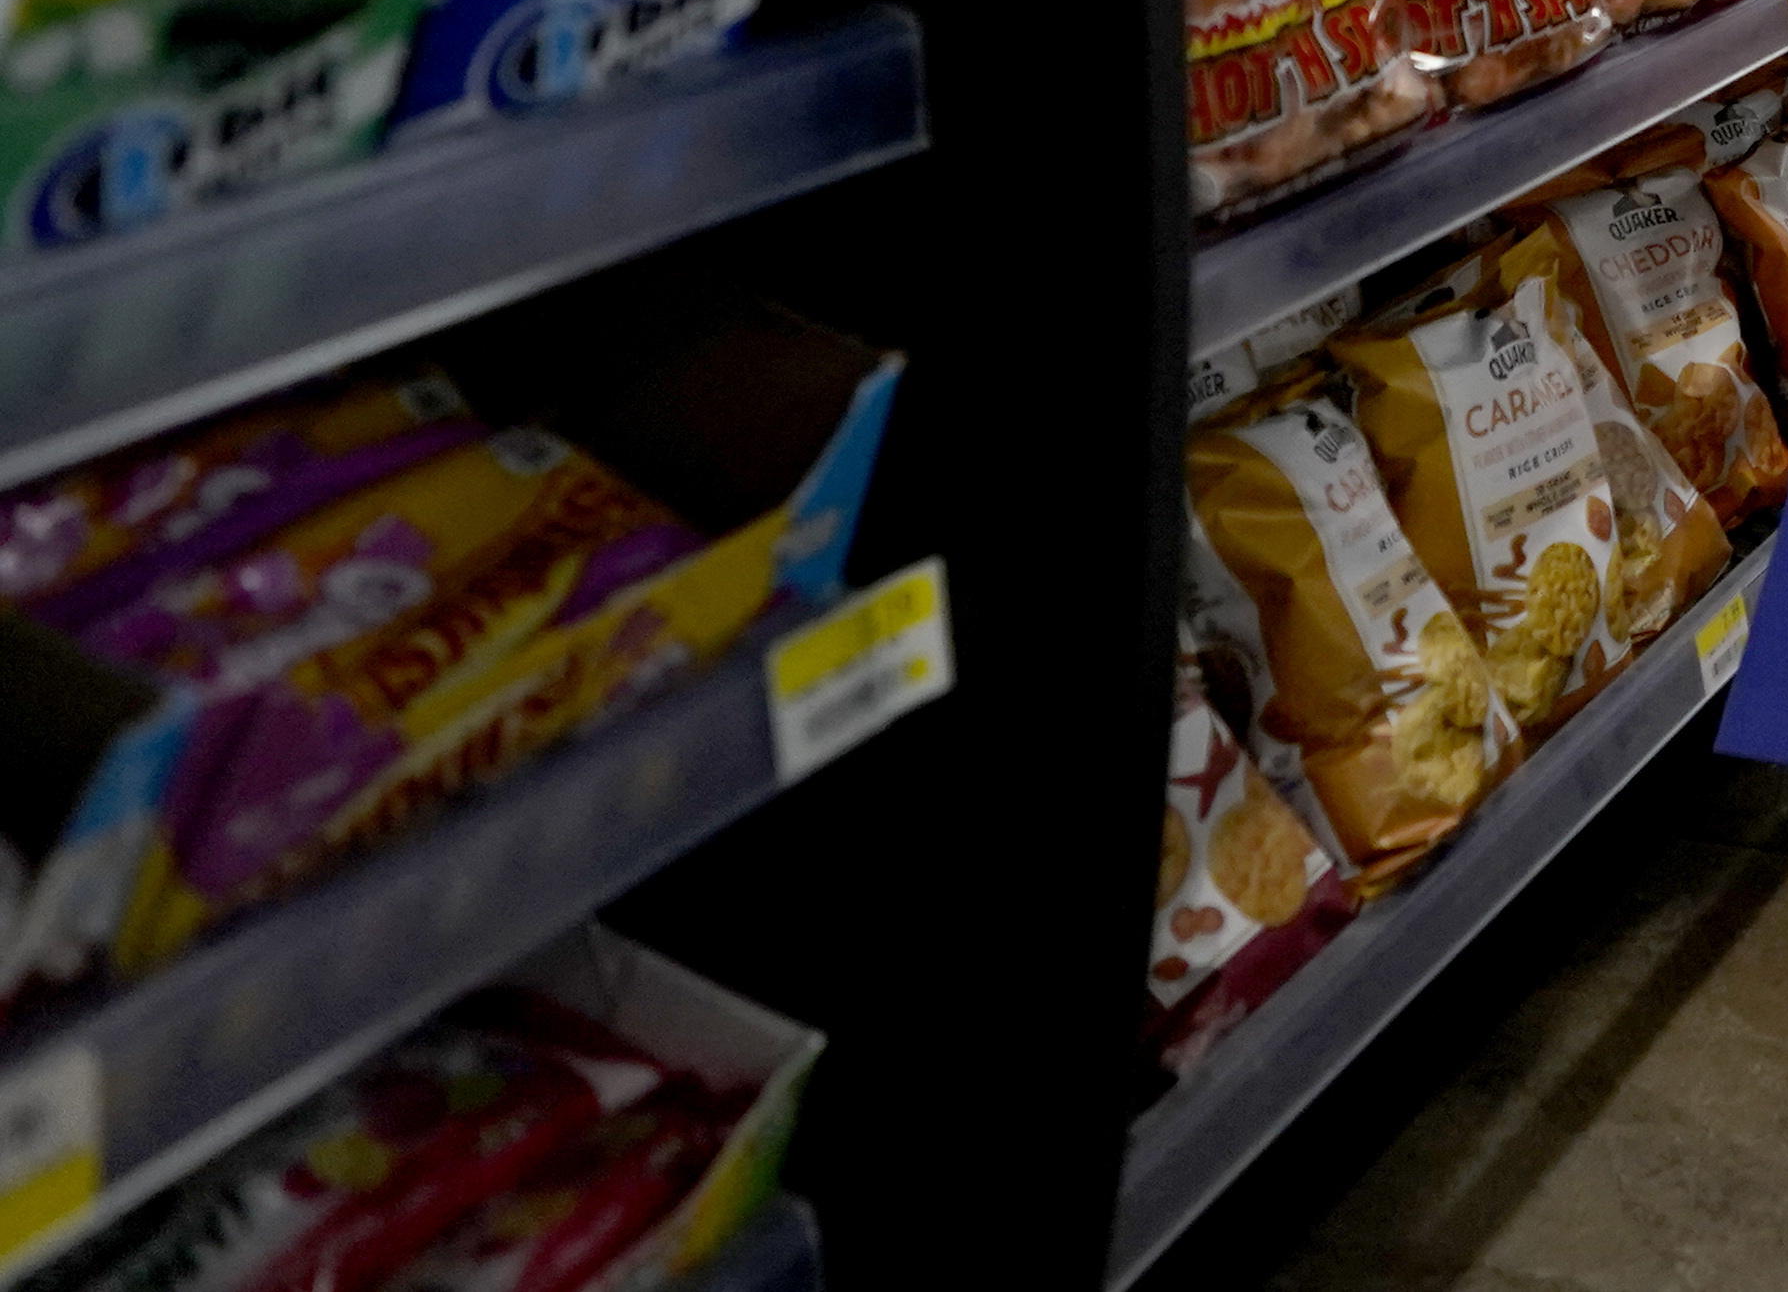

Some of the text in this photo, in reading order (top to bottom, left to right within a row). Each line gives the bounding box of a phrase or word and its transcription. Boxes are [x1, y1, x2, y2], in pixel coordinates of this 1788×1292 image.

[1609, 208, 1679, 240] QUAKER
[1600, 225, 1715, 282] CHEDDAR
[1465, 370, 1573, 438] CARAMEL
[1508, 454, 1539, 480] RICE
